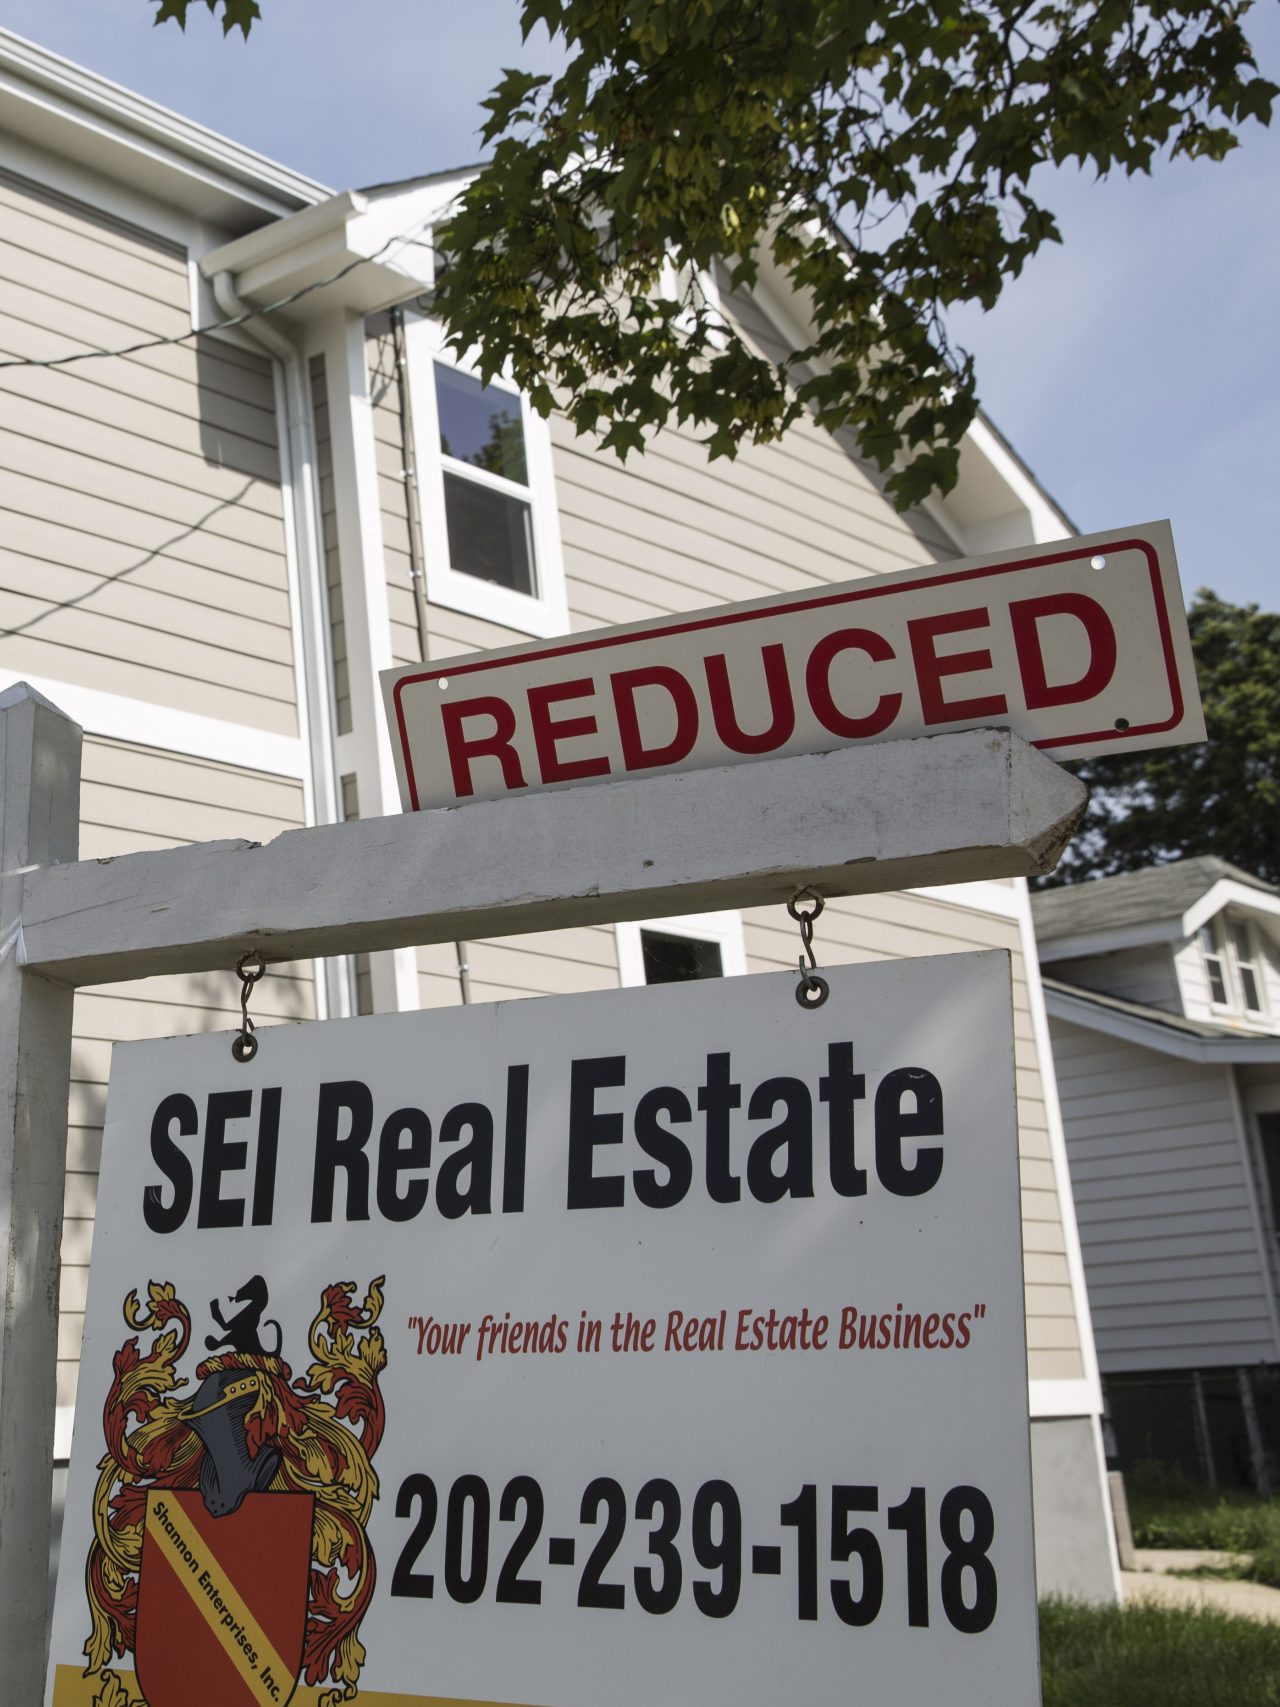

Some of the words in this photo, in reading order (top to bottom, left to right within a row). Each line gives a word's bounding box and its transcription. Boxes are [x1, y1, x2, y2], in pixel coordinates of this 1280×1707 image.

[440, 592, 1117, 797] REDUCED
[142, 1087, 283, 1235] SEI
[310, 1063, 530, 1224] Real
[566, 1041, 945, 1210] Estate
[408, 1316, 471, 1356] "Your
[476, 1312, 569, 1361] friends
[577, 1310, 602, 1353] in
[610, 1312, 657, 1353] the
[664, 1310, 727, 1352] Real
[735, 1308, 829, 1351] Estate
[838, 1303, 987, 1350] Business"
[152, 1501, 200, 1574] Shannon
[197, 1570, 259, 1671] Enterprises,
[259, 1666, 281, 1703] Inc.
[390, 1472, 998, 1635] 202-239-1518
